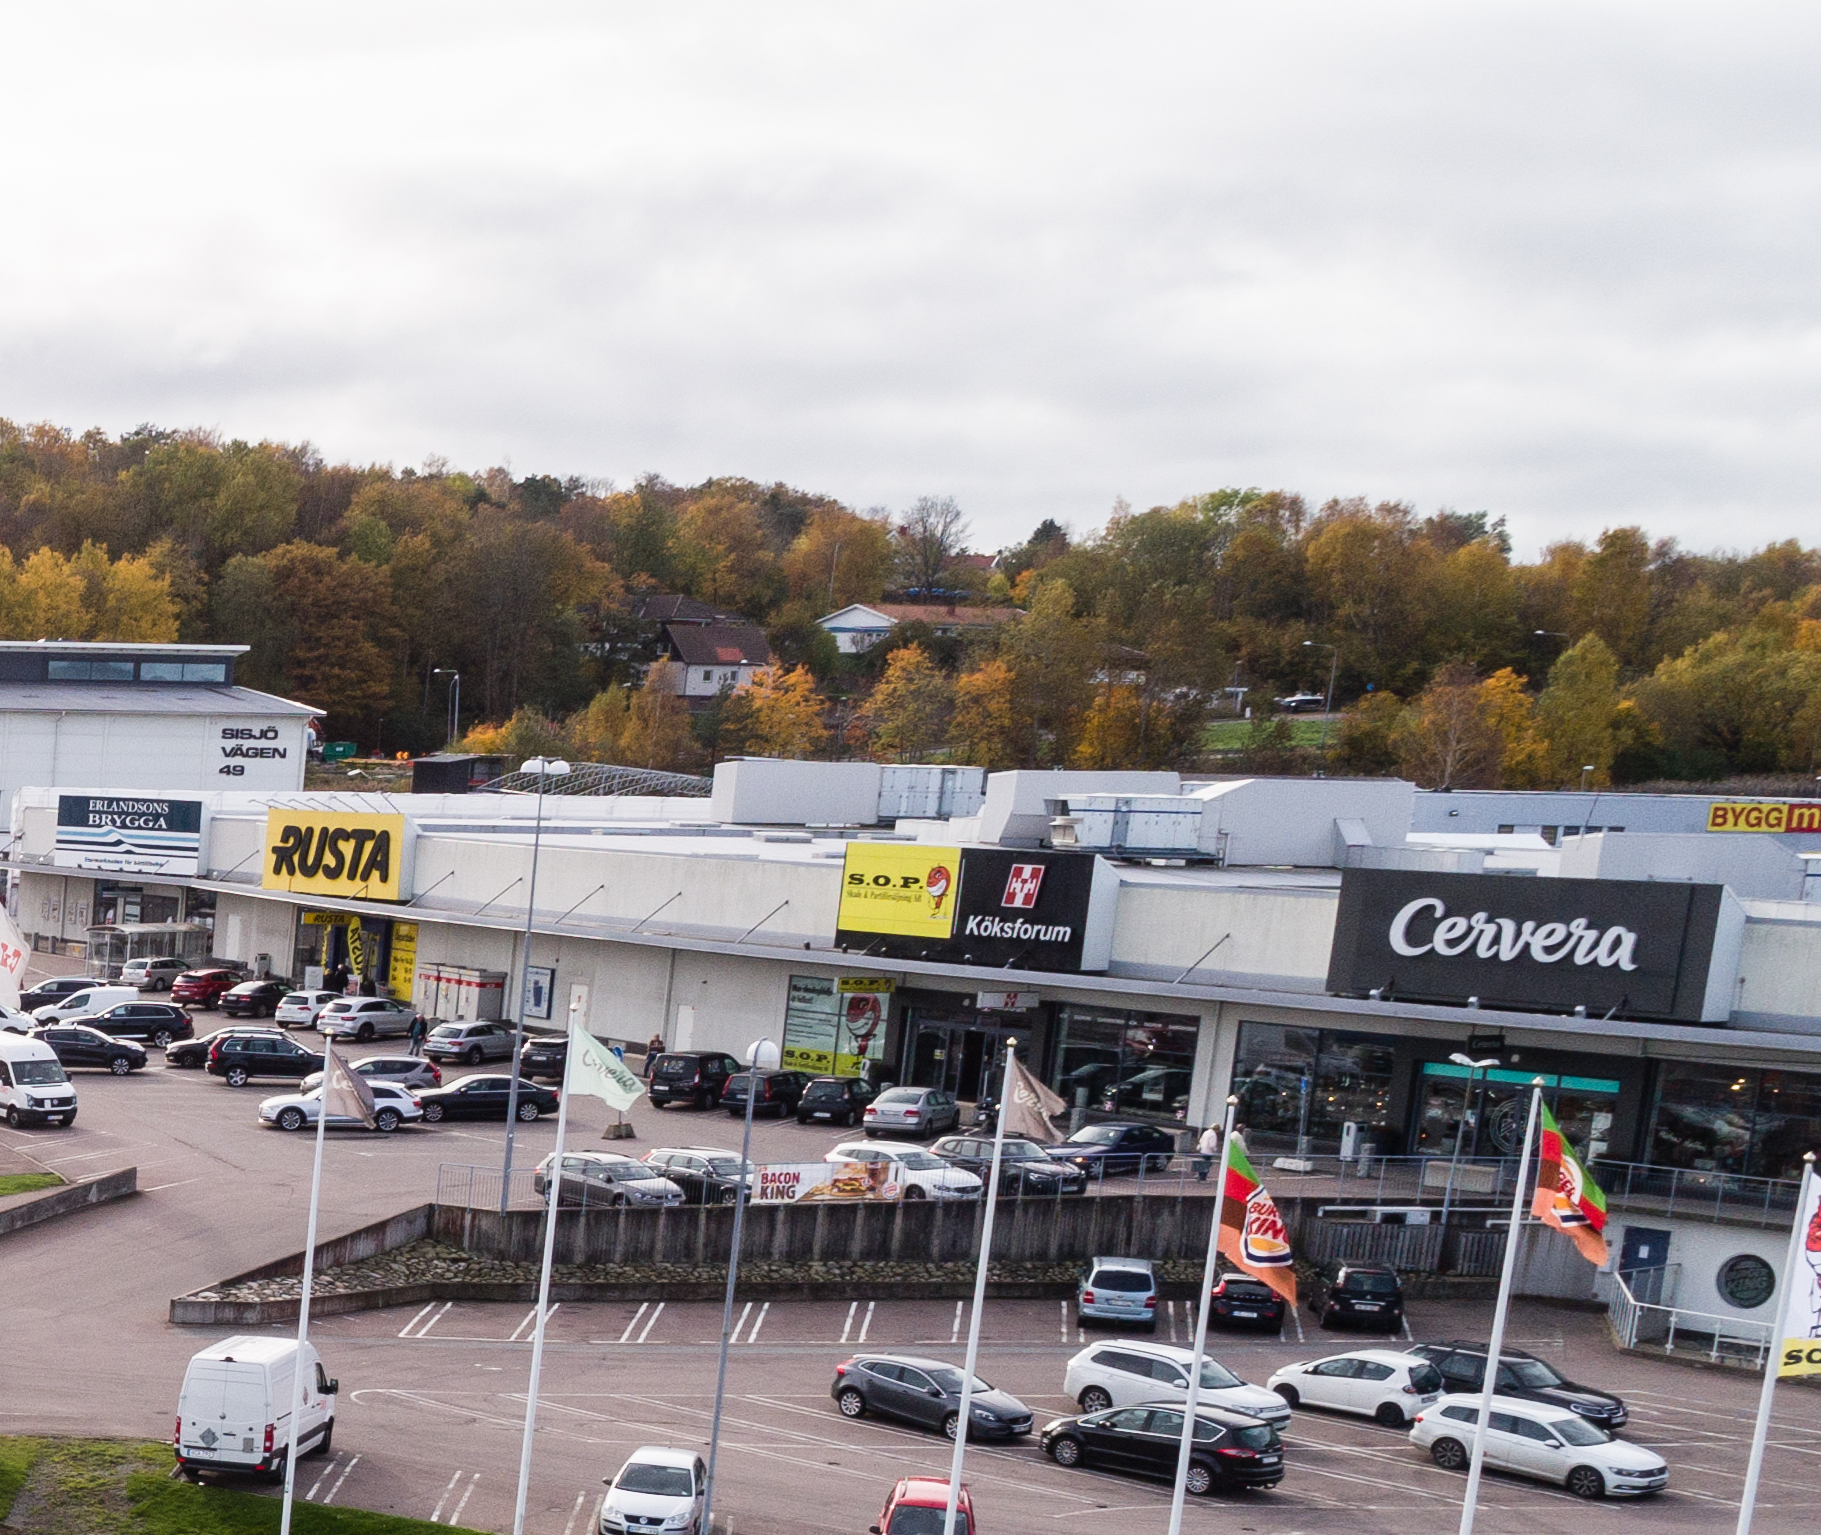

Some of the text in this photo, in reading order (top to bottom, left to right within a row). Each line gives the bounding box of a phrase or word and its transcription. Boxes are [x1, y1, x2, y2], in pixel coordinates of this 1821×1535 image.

[221, 726, 278, 741] SISJÖ
[221, 744, 287, 759] VÄGEN
[219, 765, 245, 776] 49
[89, 800, 170, 814] ERLANDSONS
[88, 813, 168, 829] BRYGGA
[271, 825, 391, 883] RUSTA
[848, 873, 924, 890] S.O.P.
[313, 913, 346, 924] RUSTA
[965, 915, 1072, 943] Köksforum
[1388, 897, 1639, 972] Cervera
[760, 1171, 800, 1185] BACON
[760, 1184, 796, 1200] KING
